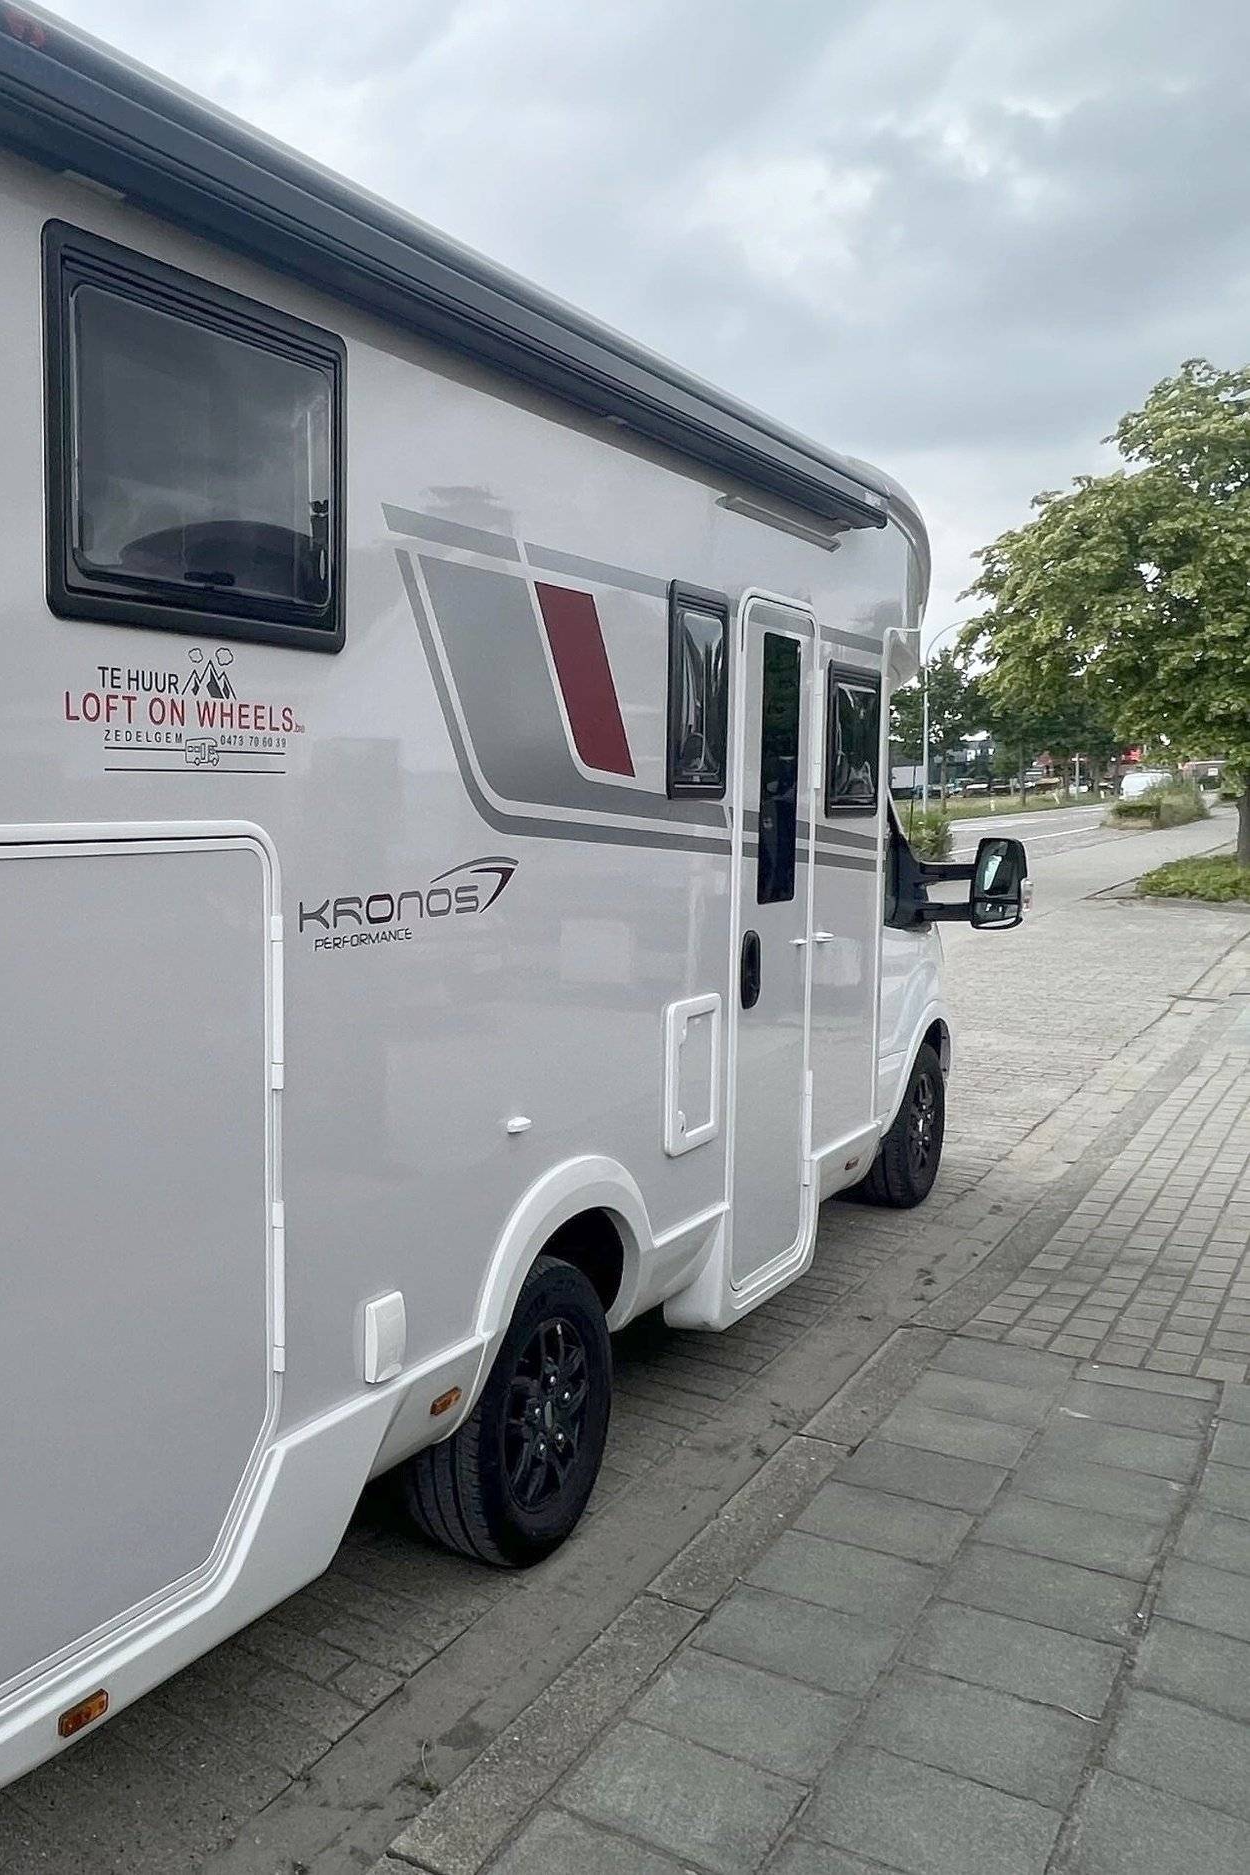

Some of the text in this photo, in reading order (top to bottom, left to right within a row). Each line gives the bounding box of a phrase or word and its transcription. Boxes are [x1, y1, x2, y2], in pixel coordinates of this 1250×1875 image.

[98, 666, 179, 694] TE HUUR
[65, 691, 138, 725] LOFT
[149, 697, 185, 727] ON
[104, 729, 183, 744] ZEDELGEM
[299, 884, 479, 933] KRONOS
[314, 928, 413, 951] PERFORMANCE
